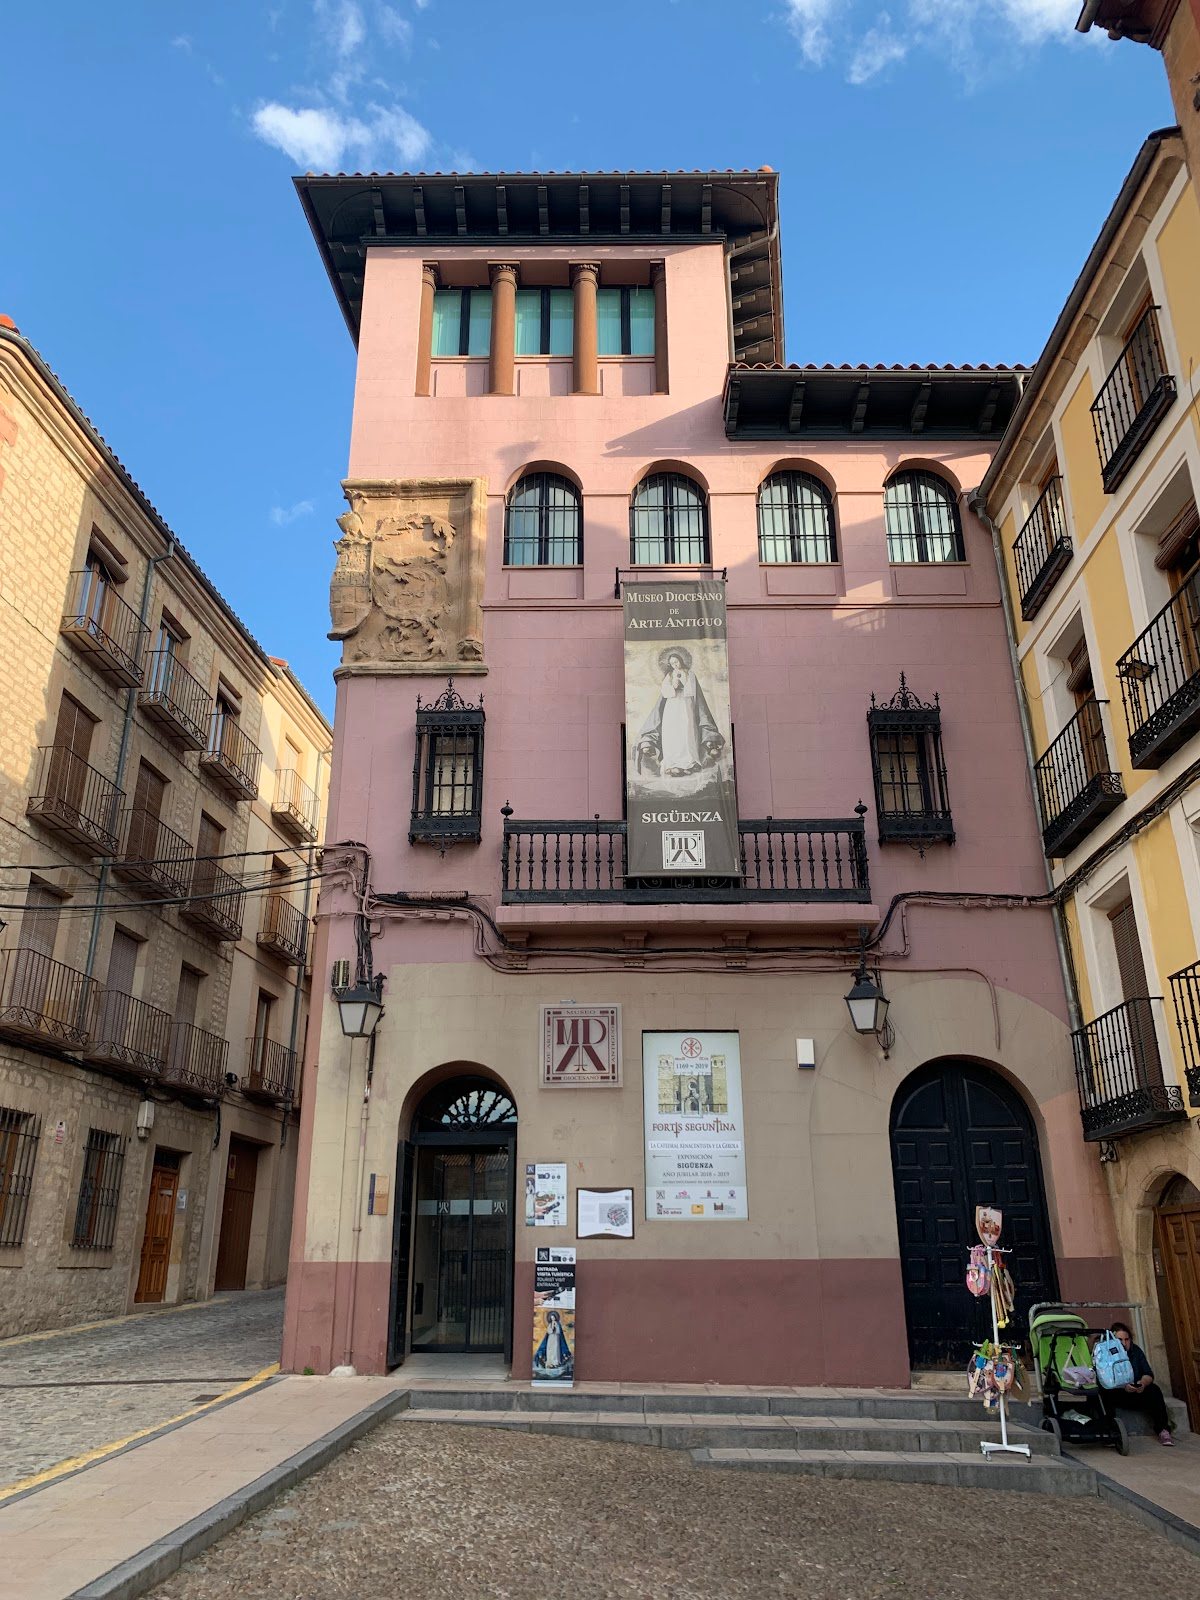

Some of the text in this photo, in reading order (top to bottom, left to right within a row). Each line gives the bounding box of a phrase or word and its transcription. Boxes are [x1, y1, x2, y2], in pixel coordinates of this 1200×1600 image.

[627, 591, 722, 603] MUSEO DIOCESANO
[628, 617, 722, 628] ARTE ANTIGUO
[641, 810, 723, 823] SIGÜENZA
[685, 1118, 736, 1133] SEGUNTINA
